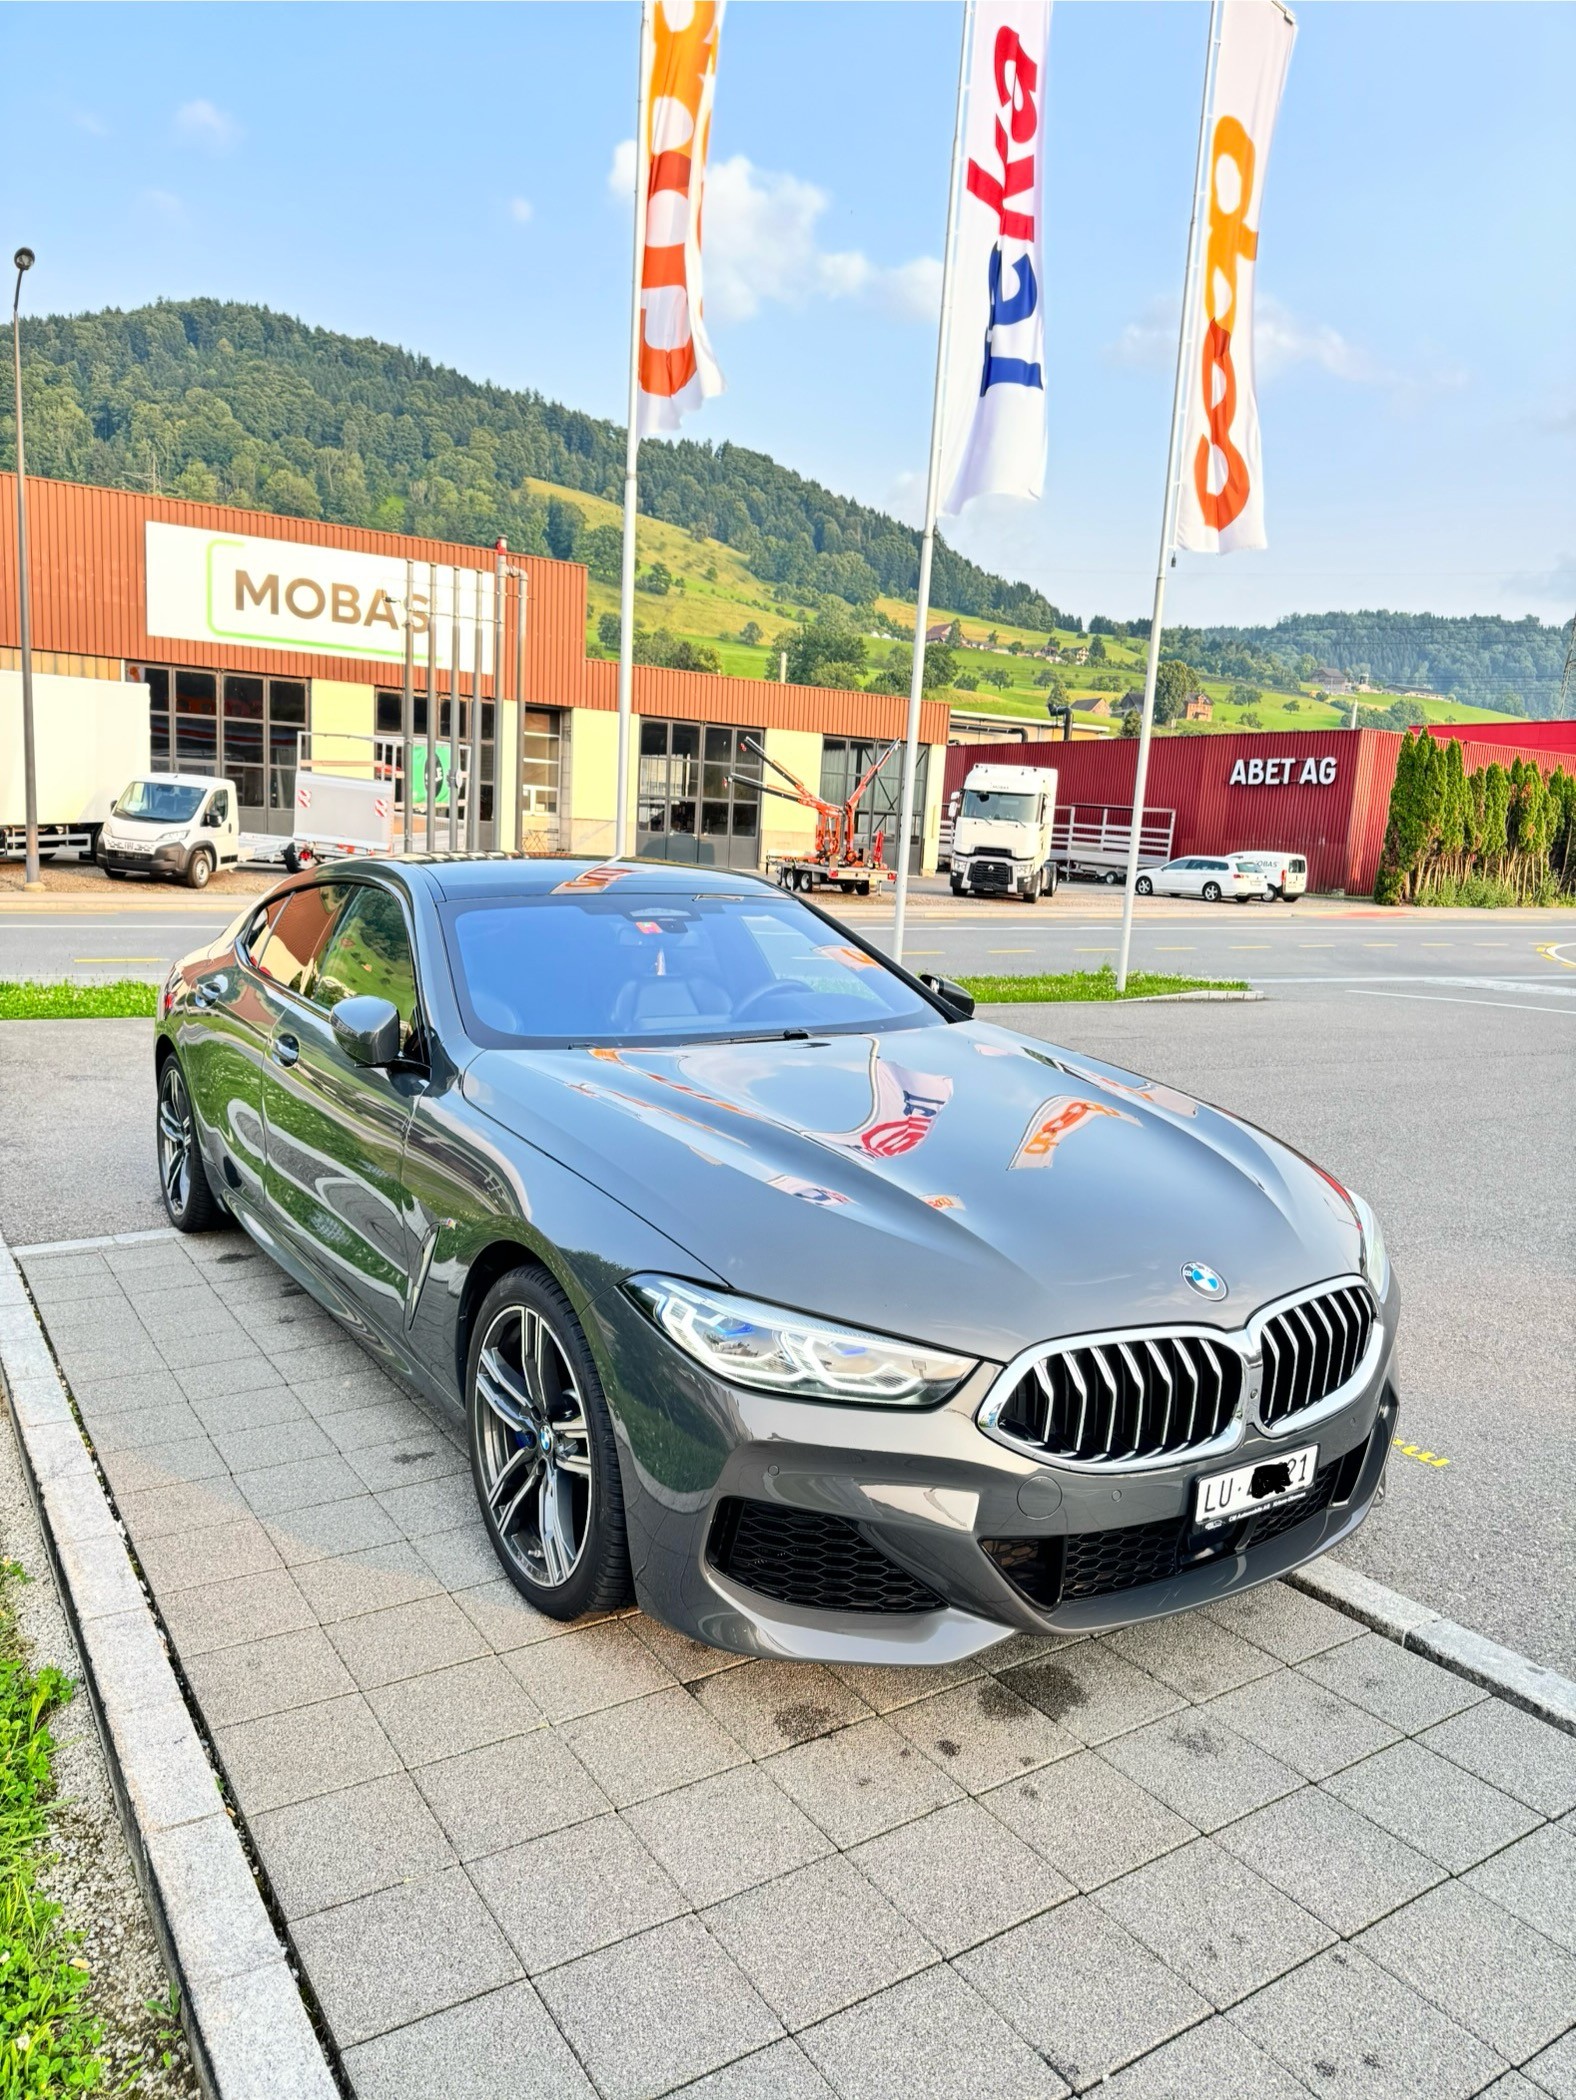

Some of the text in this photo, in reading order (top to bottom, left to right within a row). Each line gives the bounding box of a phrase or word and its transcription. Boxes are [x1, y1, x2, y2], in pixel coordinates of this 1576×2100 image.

[235, 569, 431, 634] MOBAS
[1229, 756, 1337, 786] ABET AG
